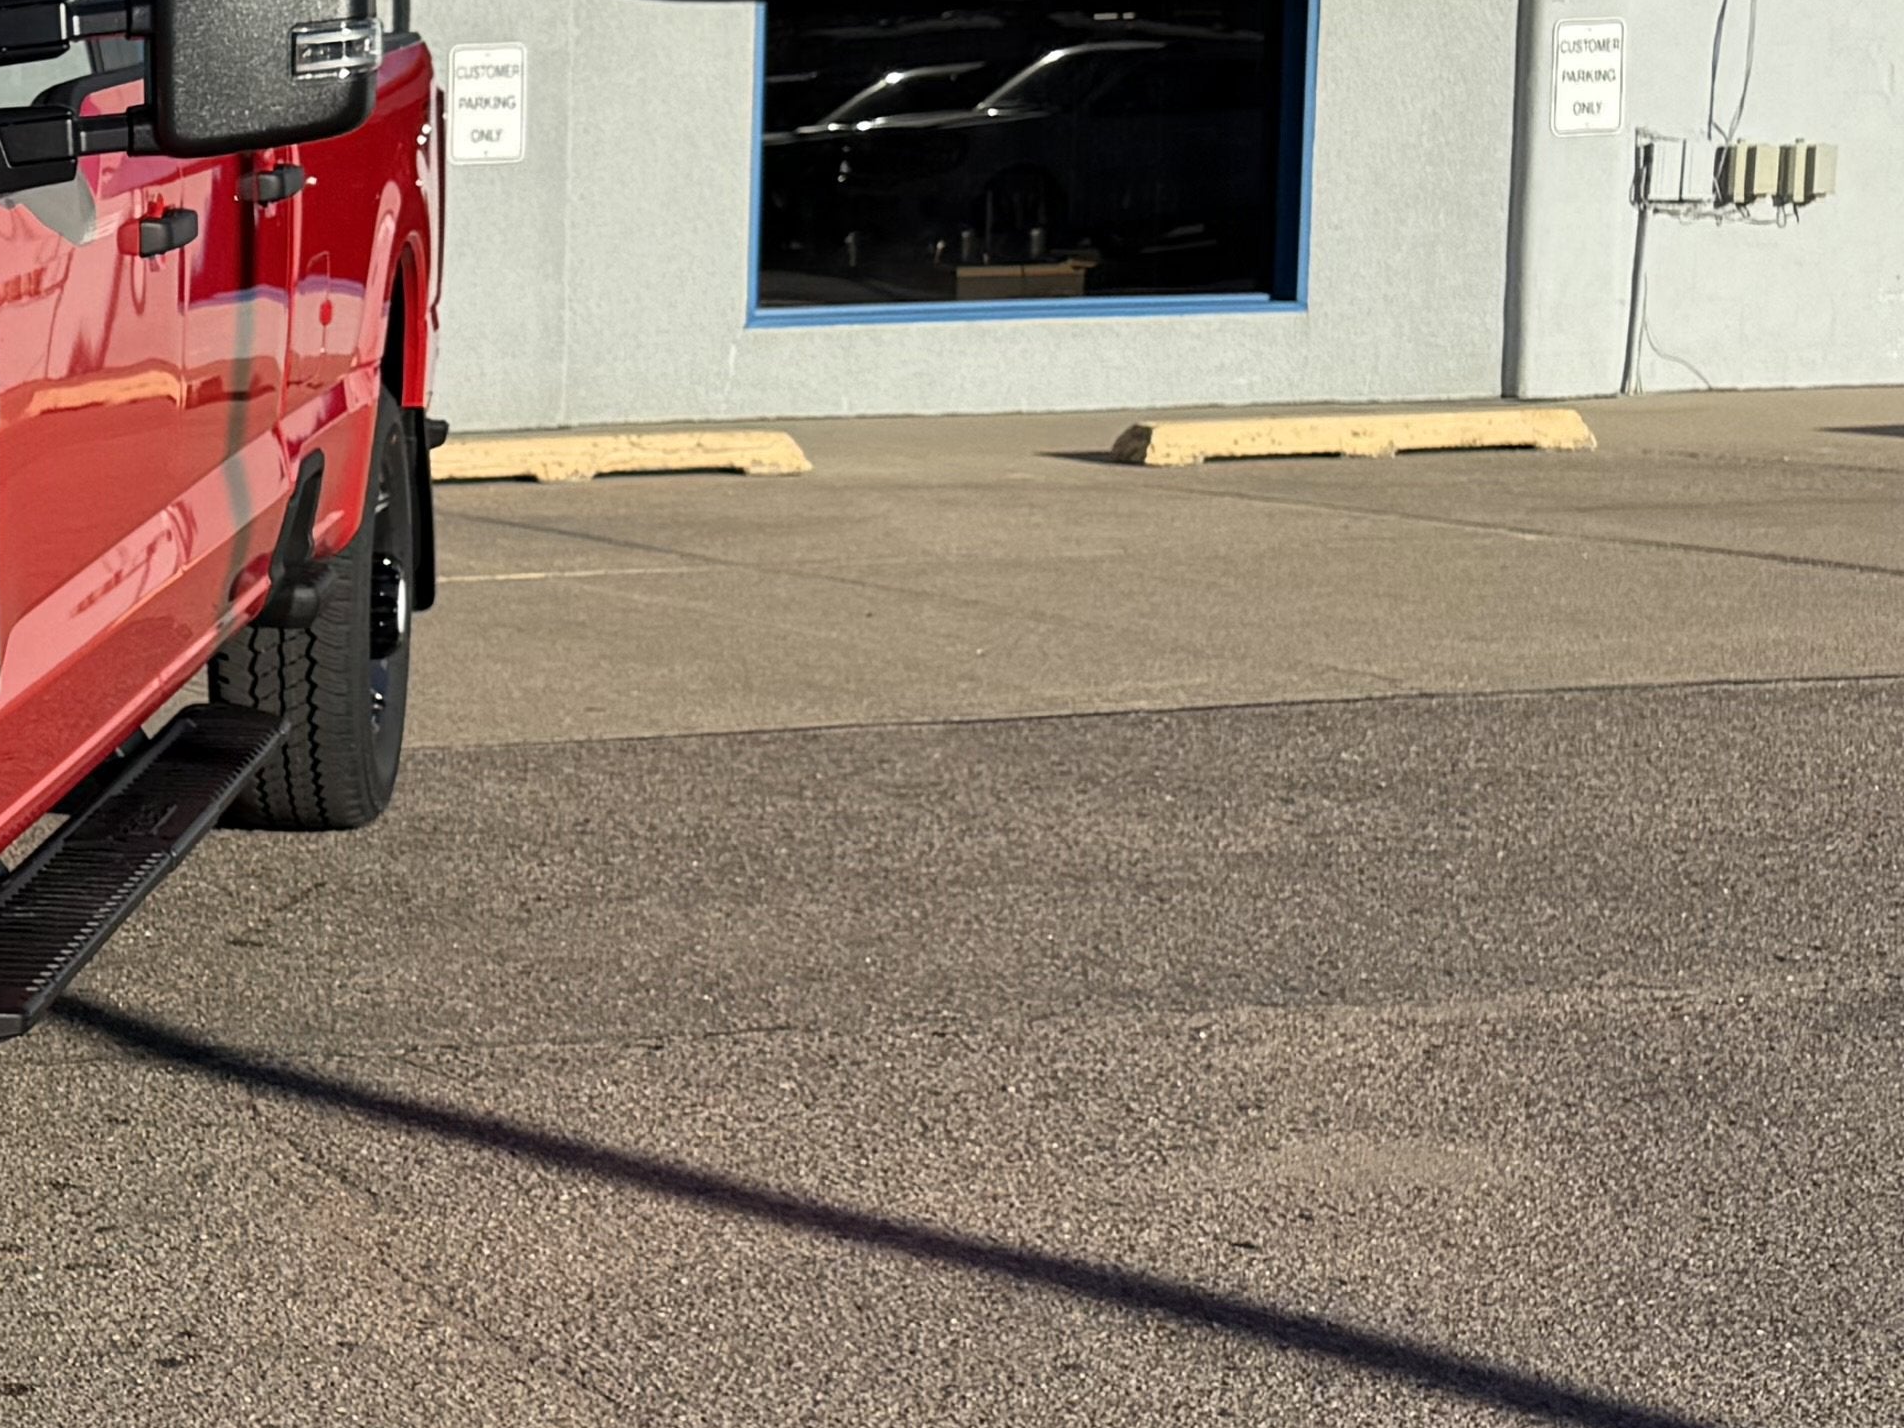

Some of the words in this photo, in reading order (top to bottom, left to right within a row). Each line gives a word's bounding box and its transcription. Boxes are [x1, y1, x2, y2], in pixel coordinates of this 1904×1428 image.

[1560, 38, 1620, 54] CUSTOMER
[455, 64, 520, 80] CUSTOMER
[1562, 69, 1616, 83] PARKING
[458, 95, 517, 110] PARKING
[1573, 101, 1603, 116] ONLY
[471, 128, 503, 143] ONLY
